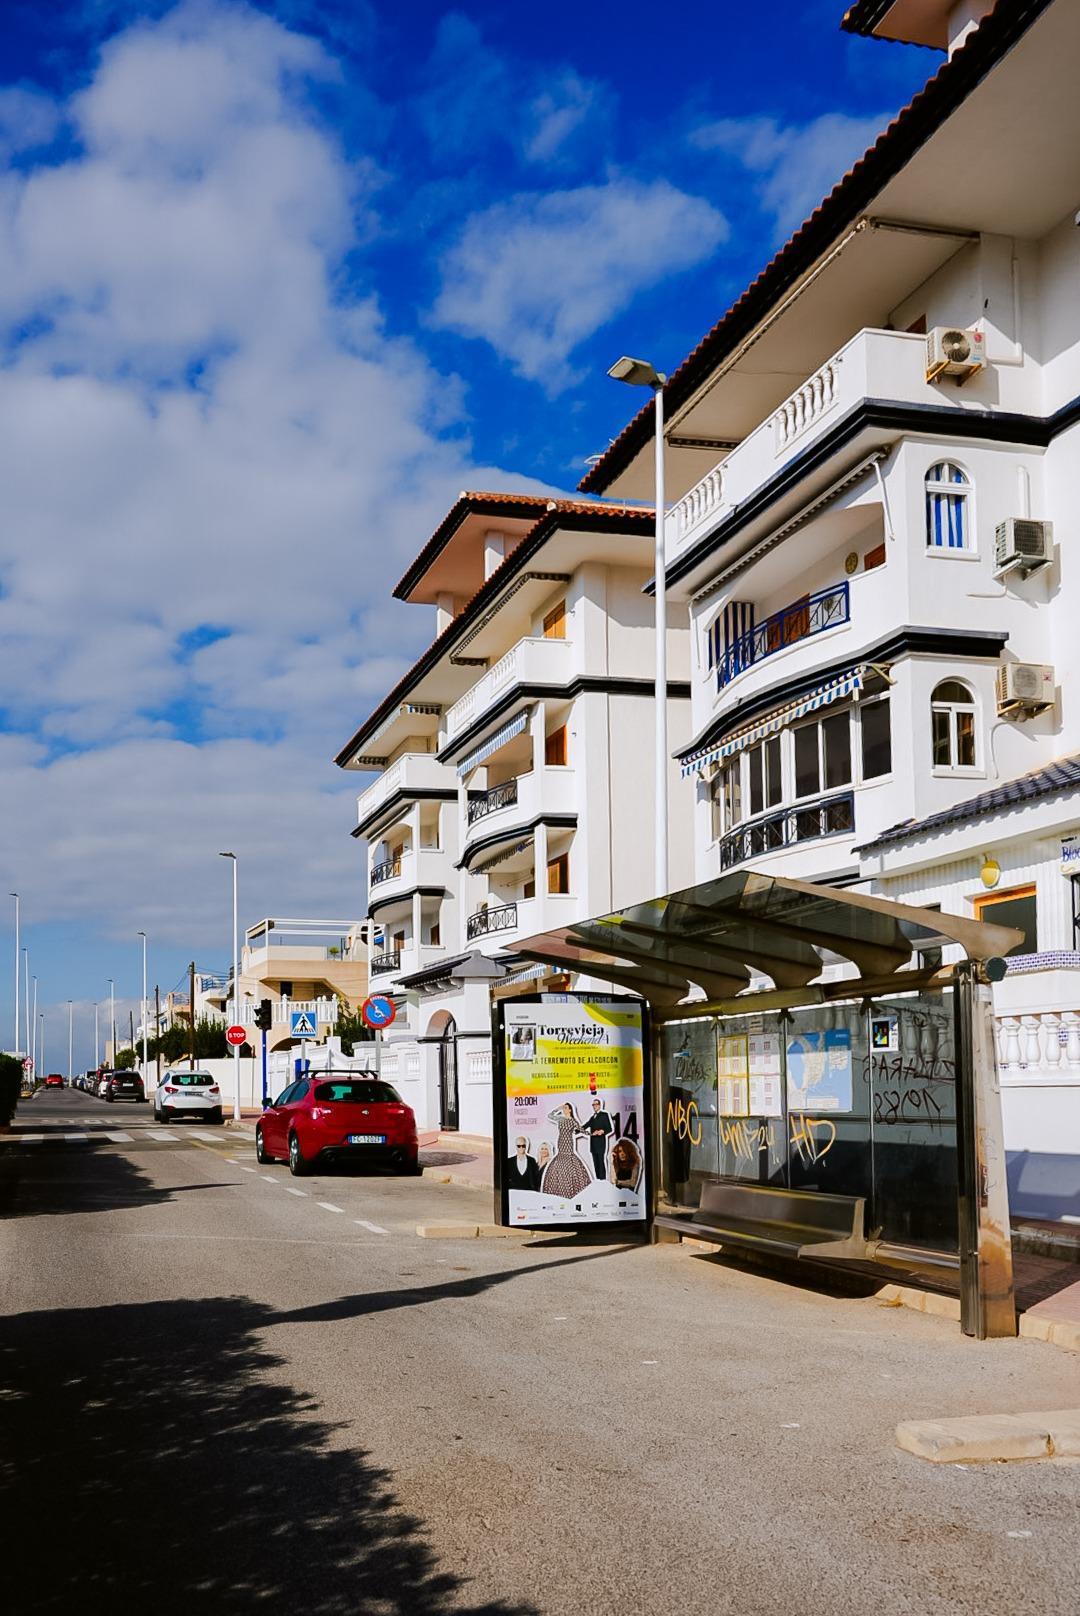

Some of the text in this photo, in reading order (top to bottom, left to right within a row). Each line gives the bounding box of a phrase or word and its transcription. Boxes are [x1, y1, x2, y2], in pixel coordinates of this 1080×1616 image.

[538, 1023, 604, 1037] Torrevieja
[541, 1056, 576, 1064] TERREMOTO
[578, 1056, 585, 1064] DE
[611, 1112, 640, 1145] 14
